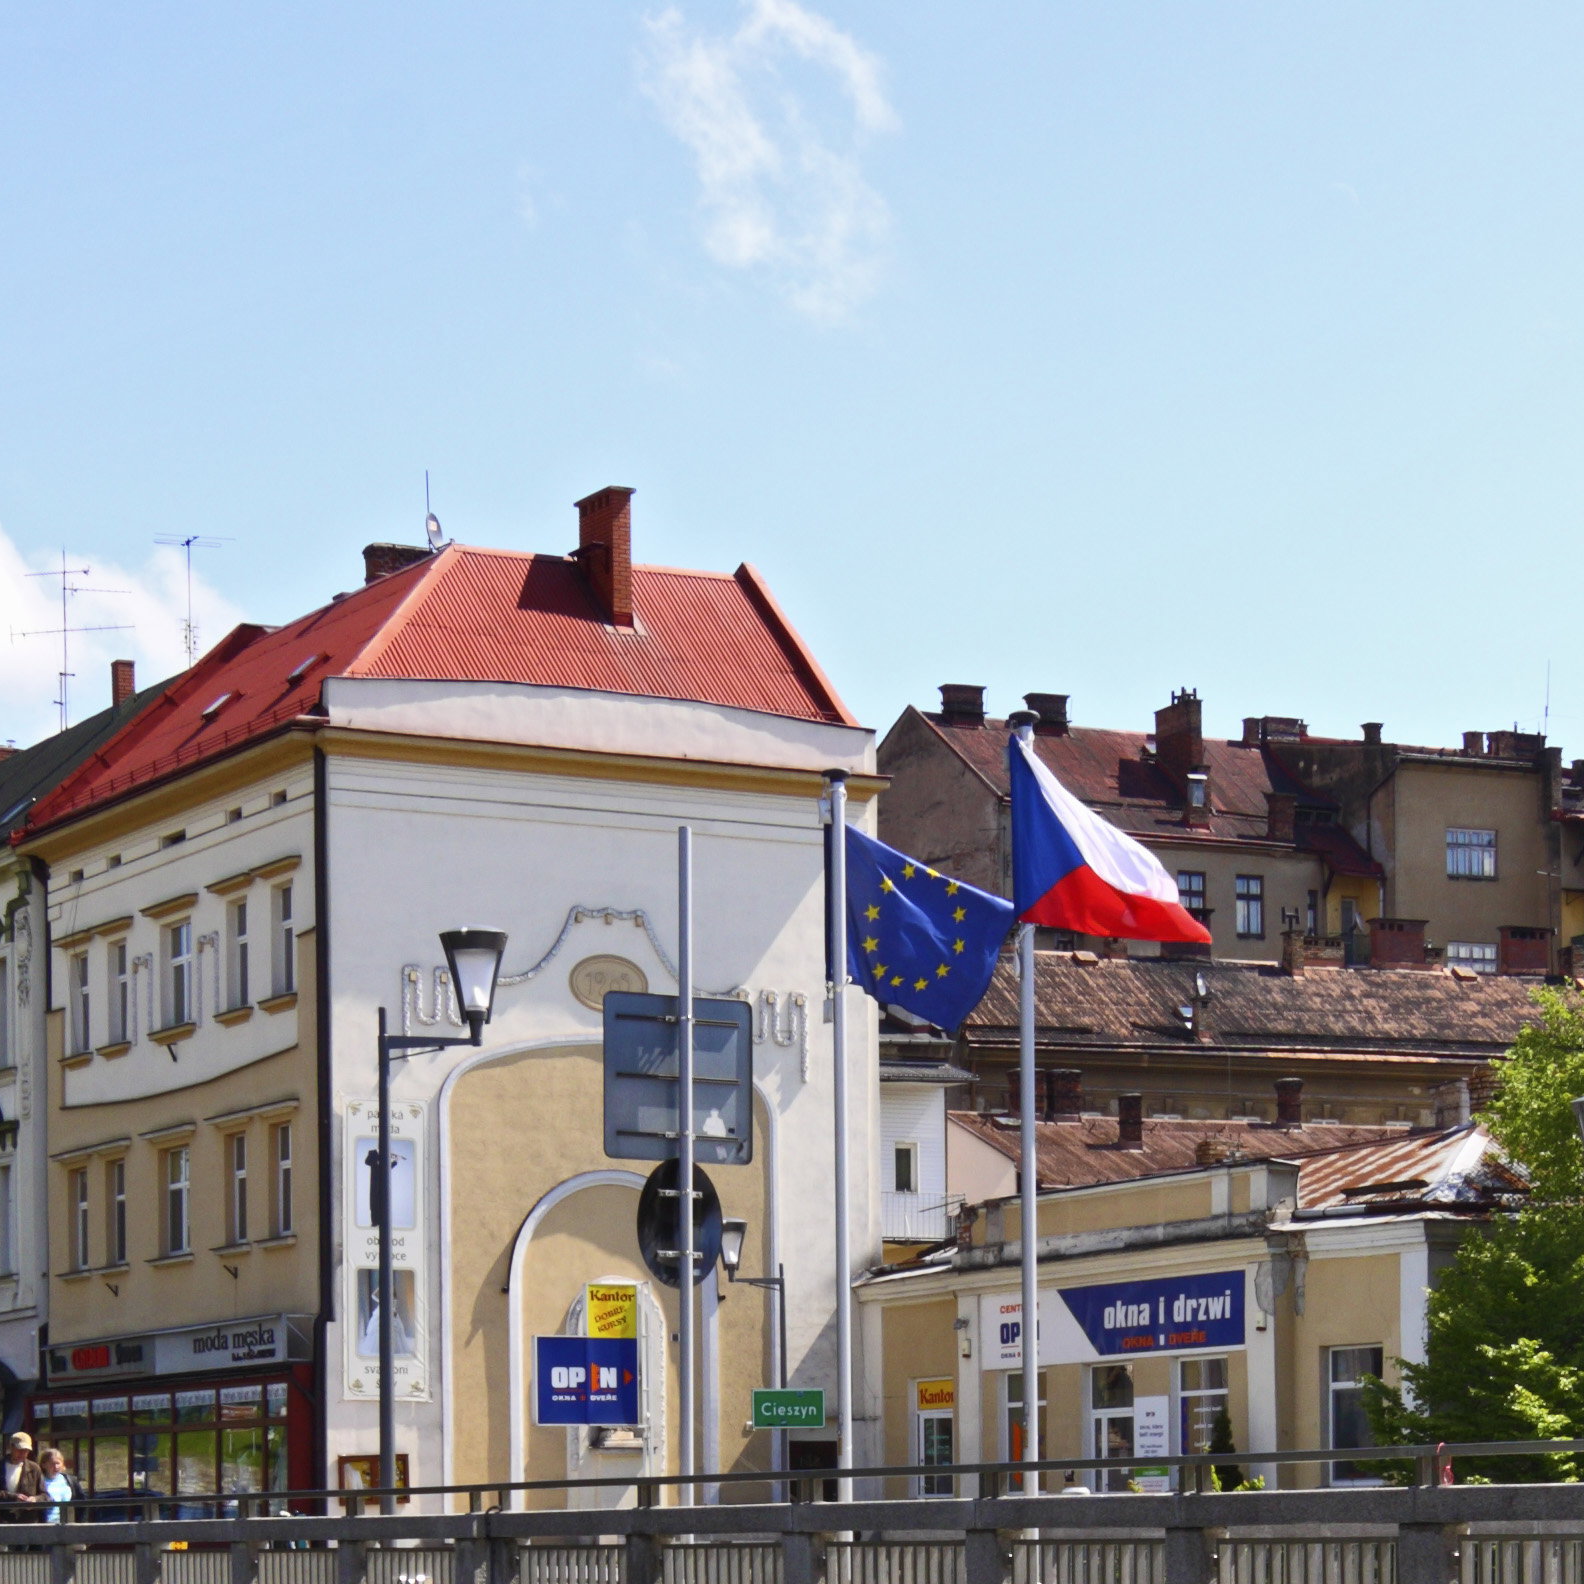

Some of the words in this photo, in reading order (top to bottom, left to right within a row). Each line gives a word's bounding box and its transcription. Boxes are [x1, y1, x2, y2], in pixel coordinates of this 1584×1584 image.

[590, 1290, 636, 1302] Kantor
[1104, 1300, 1150, 1329] okna
[1158, 1296, 1165, 1324] i
[1173, 1289, 1231, 1323] drzwi
[193, 1328, 228, 1354] moda
[232, 1323, 275, 1351] męska
[761, 1402, 817, 1419] Cieszyn
